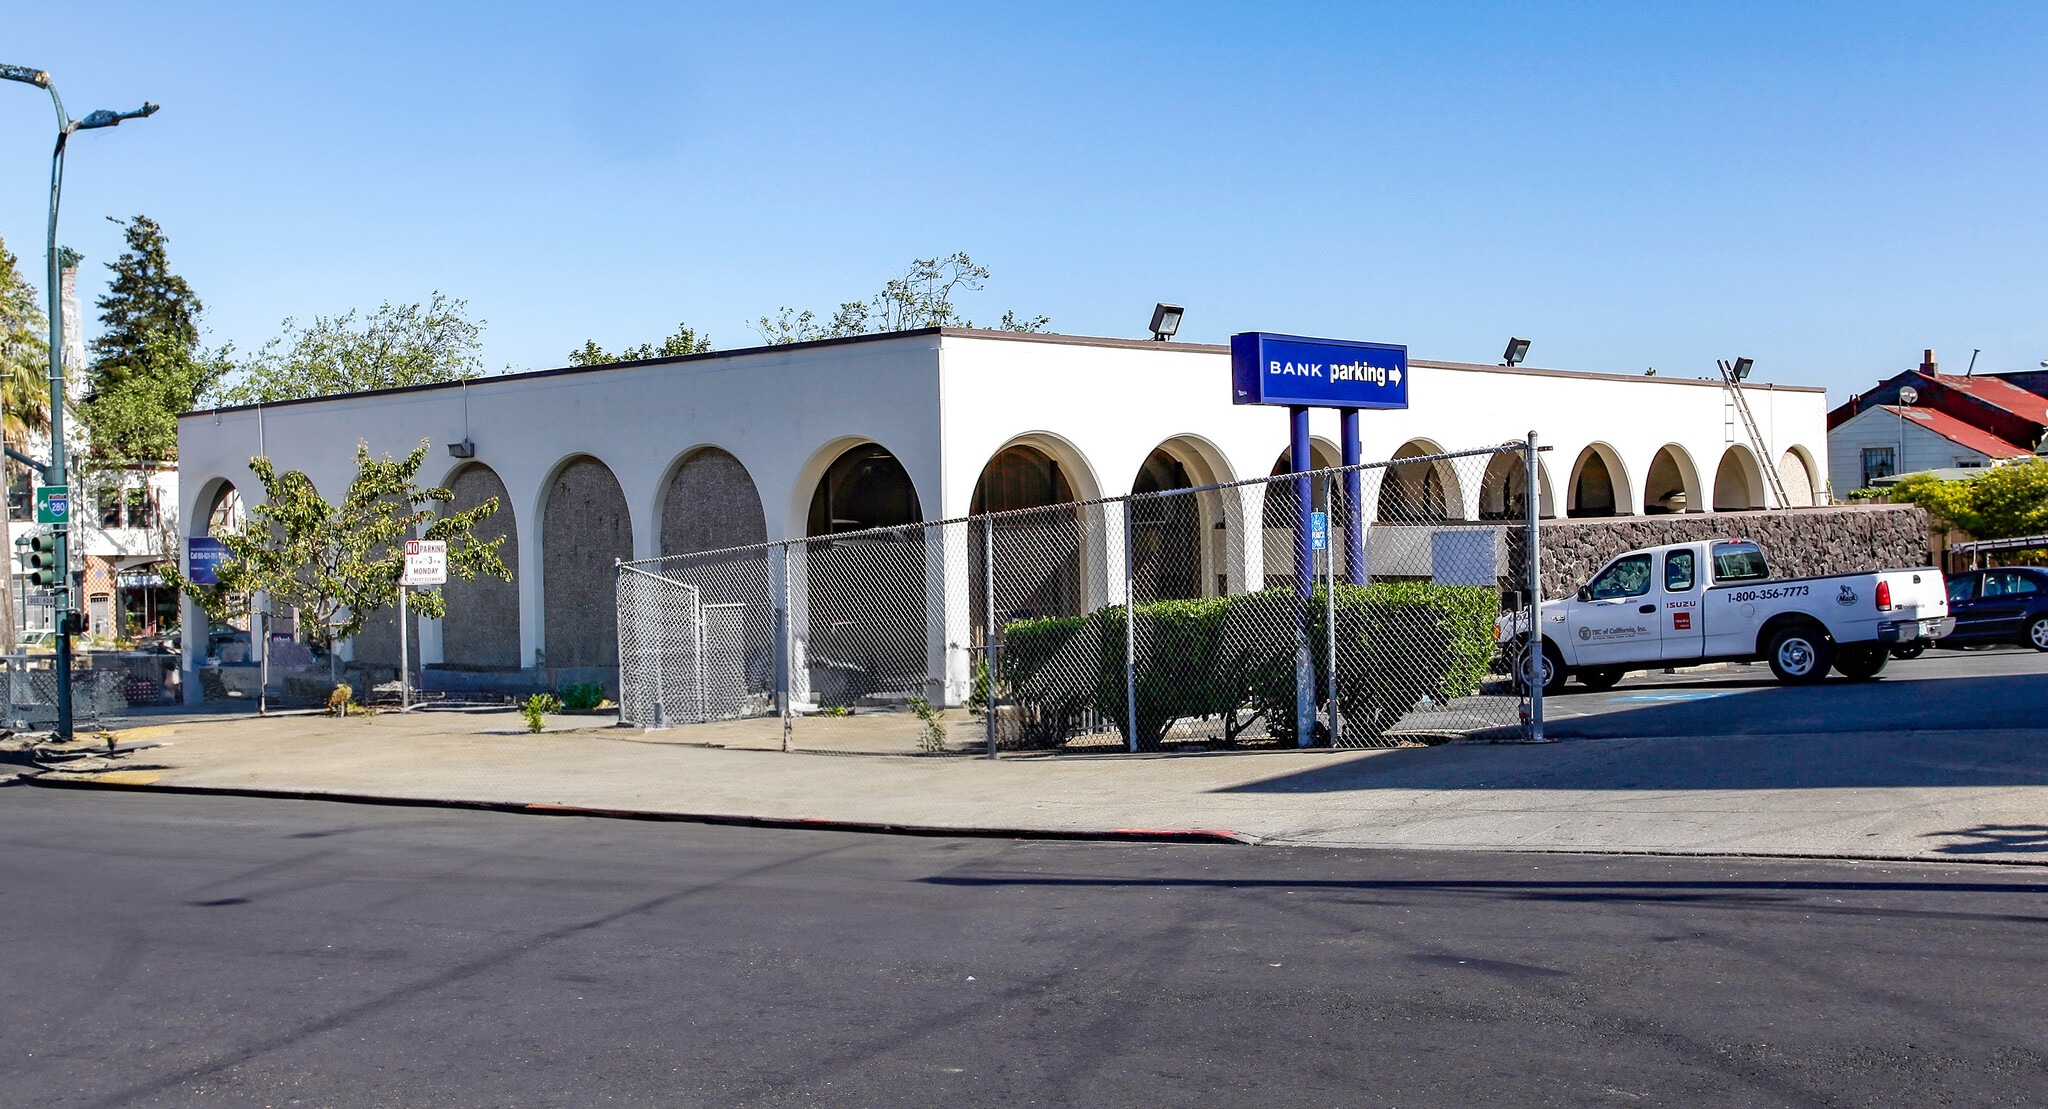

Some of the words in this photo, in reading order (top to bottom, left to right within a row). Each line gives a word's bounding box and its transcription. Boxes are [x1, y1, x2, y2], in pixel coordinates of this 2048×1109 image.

[1270, 361, 1322, 377] BANK
[1330, 360, 1386, 387] parking
[51, 502, 65, 511] 280
[407, 543, 418, 554] NO
[420, 545, 445, 553] PARKING
[428, 556, 433, 564] 3
[1727, 586, 1810, 603] 1-800-356-7773
[1838, 594, 1857, 602] Mack
[1609, 626, 1636, 634] California,
